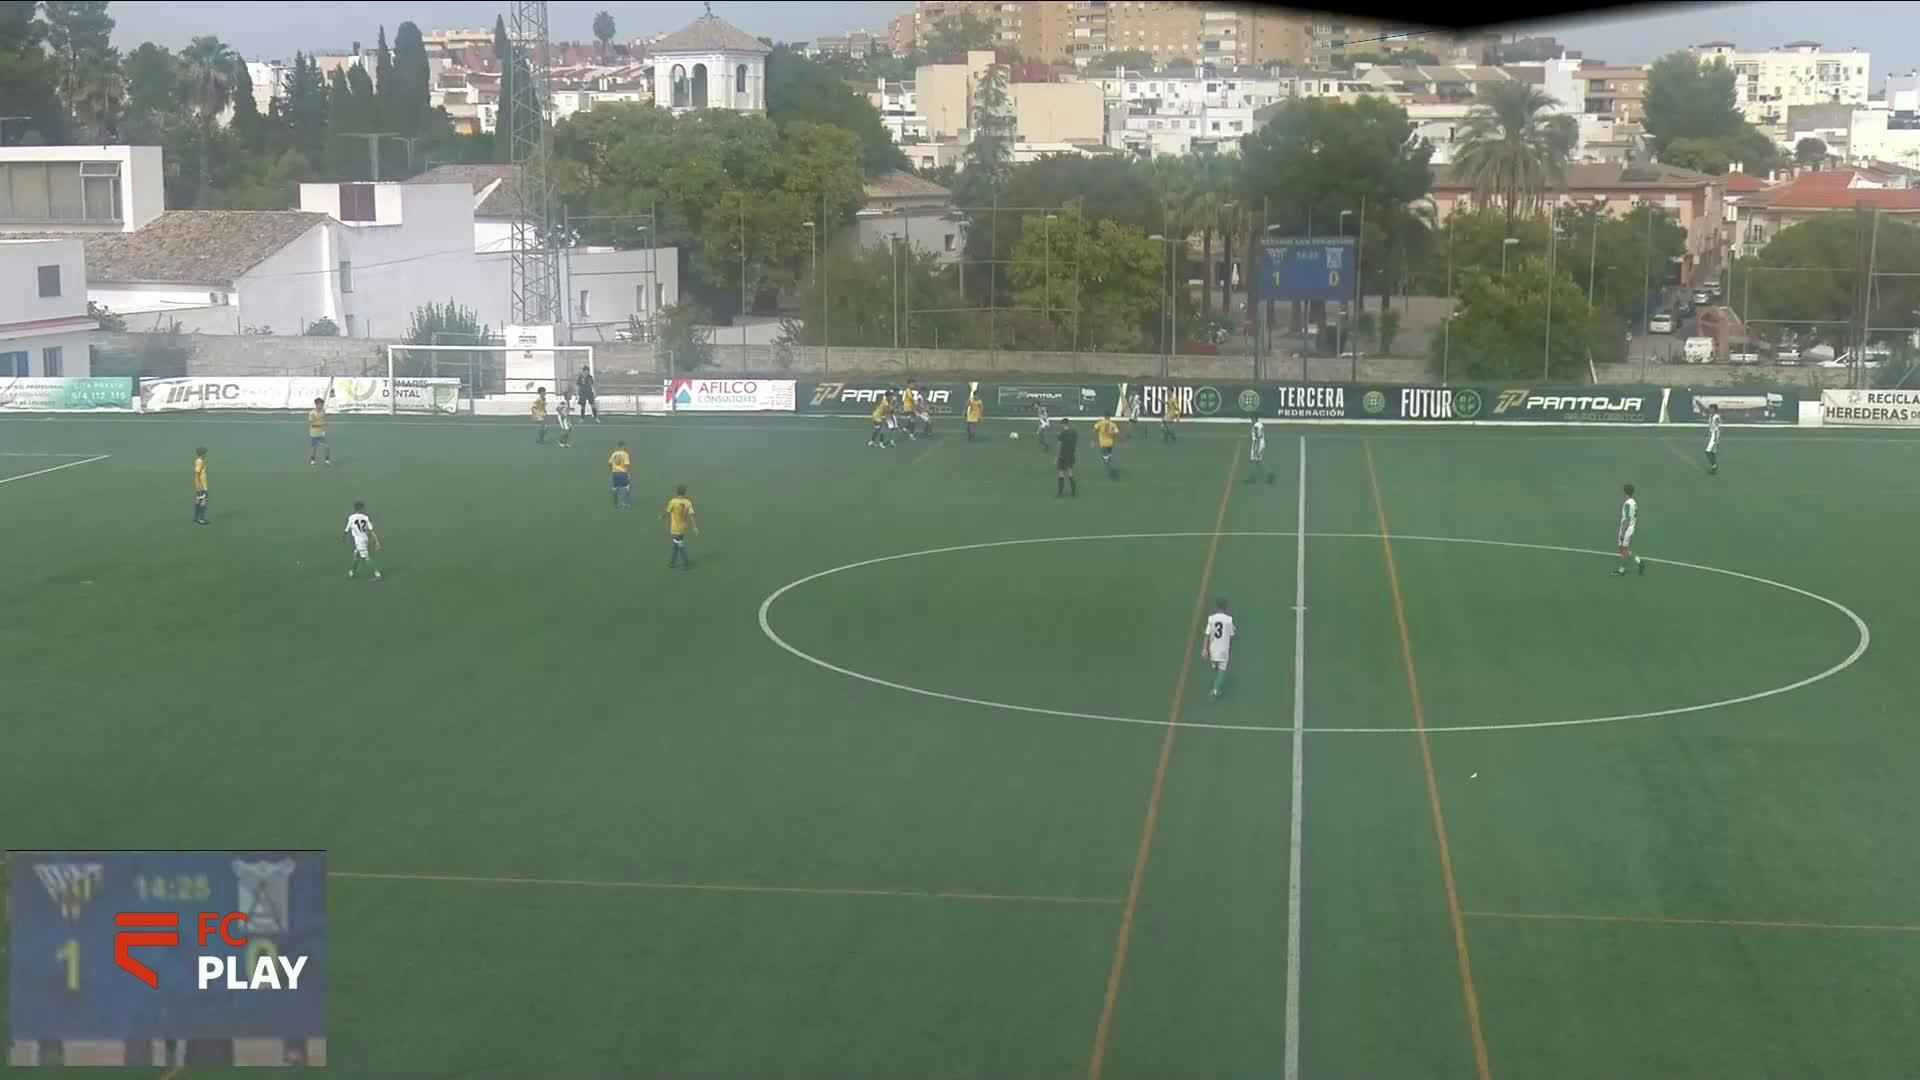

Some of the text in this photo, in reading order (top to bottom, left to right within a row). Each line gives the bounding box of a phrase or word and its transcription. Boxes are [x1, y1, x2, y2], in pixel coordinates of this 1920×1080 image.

[1272, 271, 1280, 287] 1
[1328, 270, 1339, 287] 0
[382, 379, 428, 388] TMARES
[698, 381, 757, 394] AFILCO
[697, 395, 757, 403] CONSULTORES
[1279, 387, 1344, 407] TERCERA
[1401, 389, 1452, 418] FUTUR
[1526, 397, 1642, 411] PANTOJA
[1278, 408, 1345, 417] FEDERACIÓN
[1826, 407, 1909, 420] HEREDERAS
[354, 519, 367, 532] 12
[1214, 622, 1223, 639] 3
